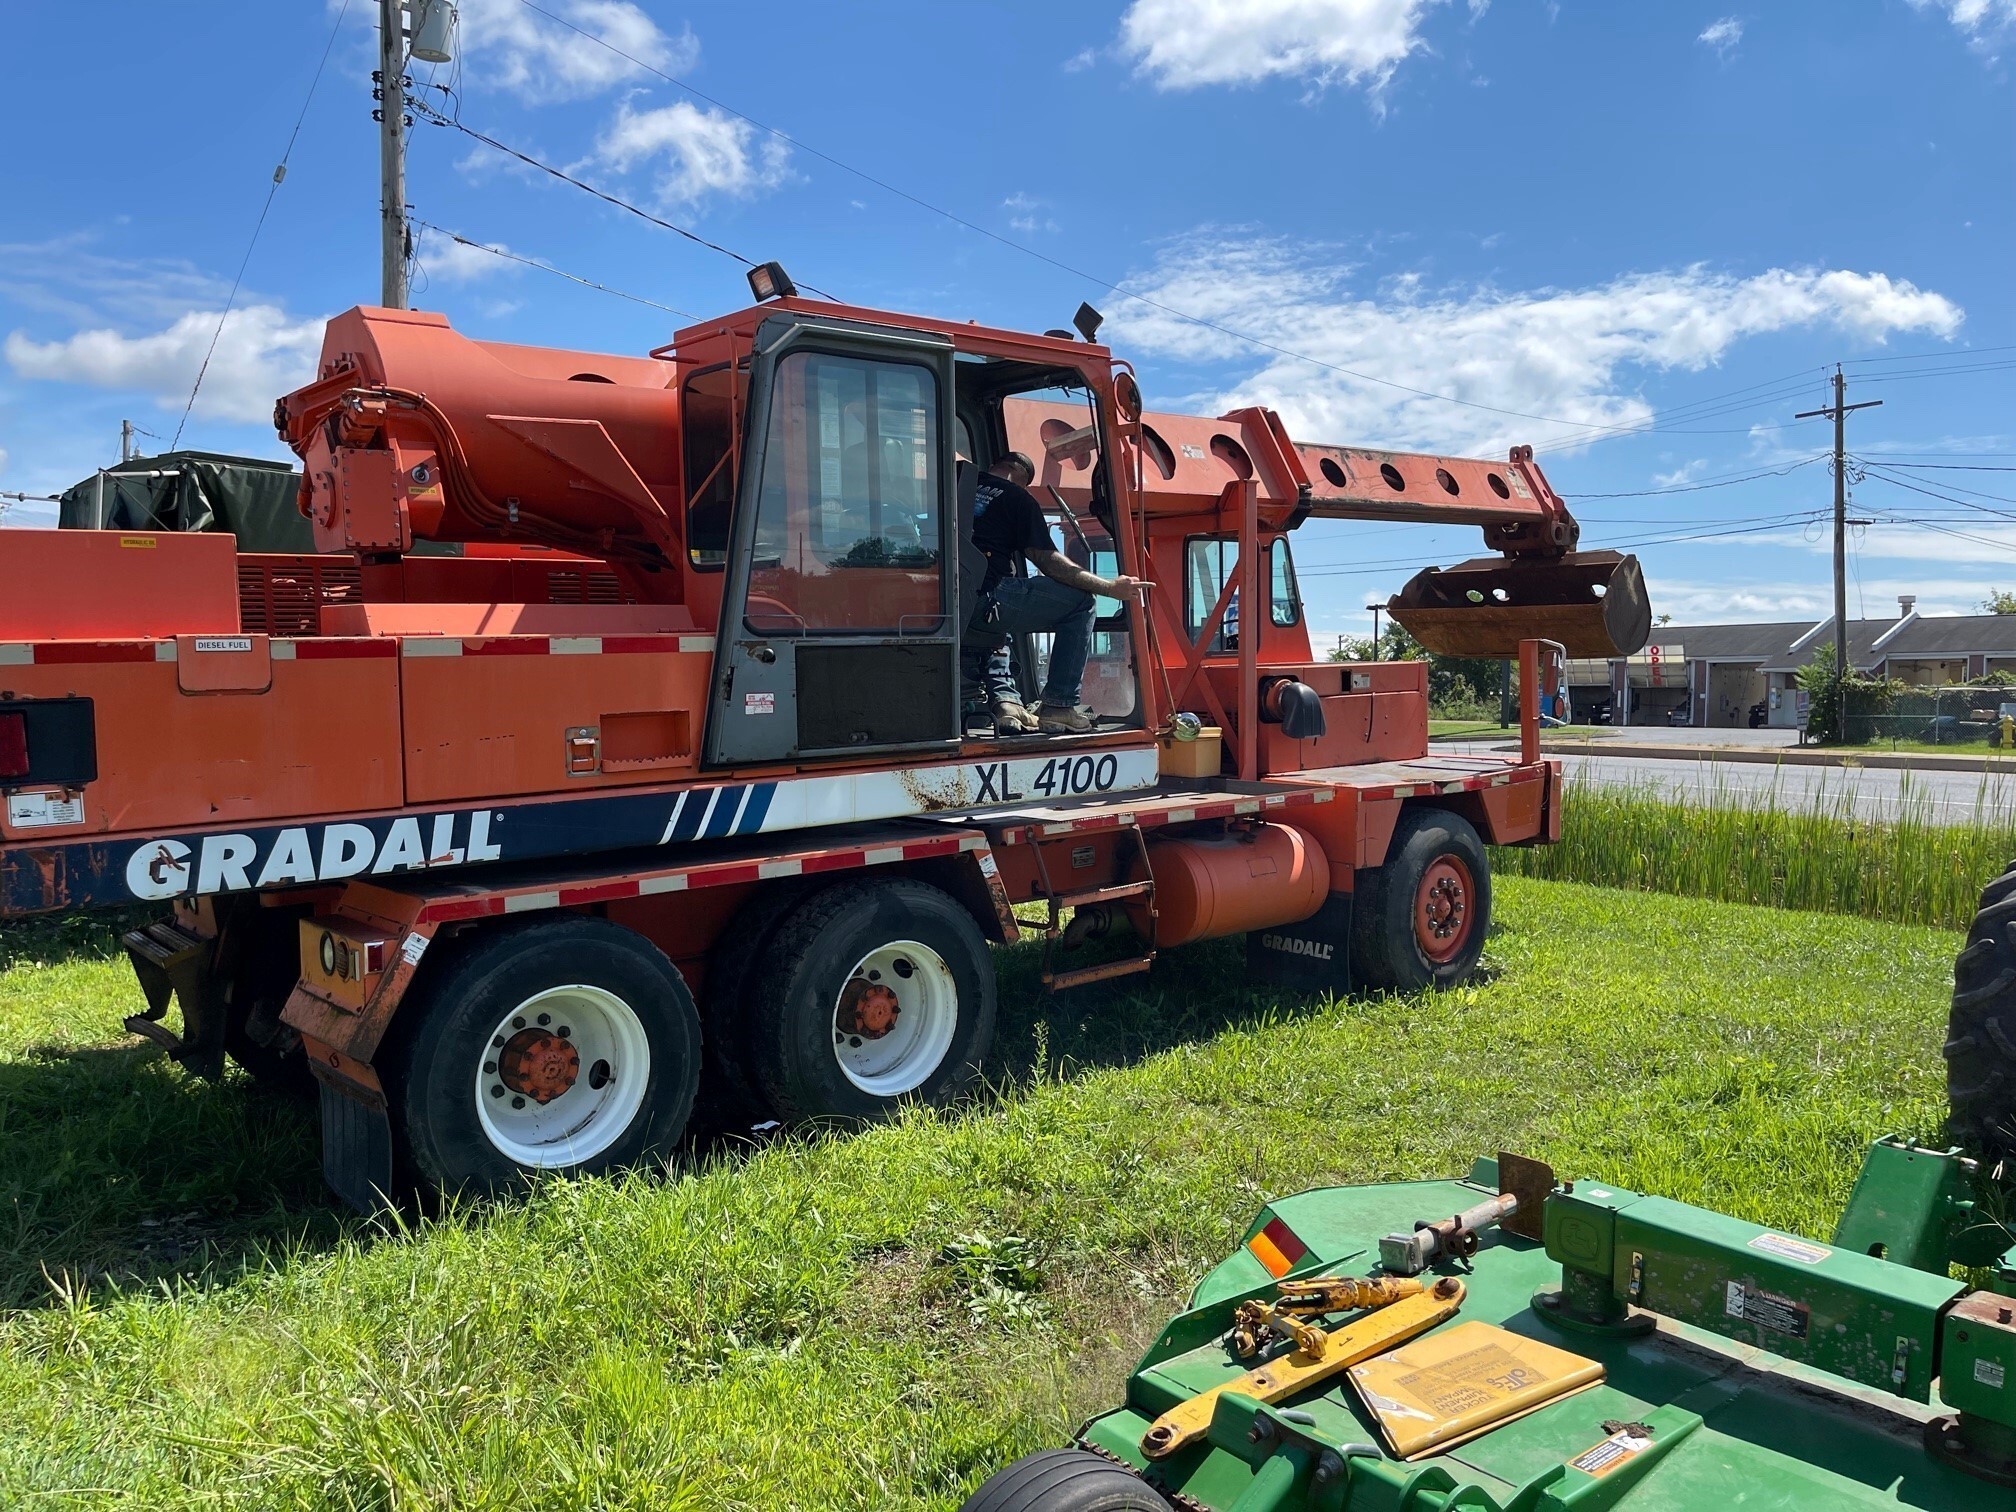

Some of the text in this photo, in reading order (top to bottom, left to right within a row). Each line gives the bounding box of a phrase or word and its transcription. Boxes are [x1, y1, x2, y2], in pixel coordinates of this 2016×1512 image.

[198, 641, 249, 649] DIESEL FUEL
[1650, 645, 1662, 687] OPEN
[974, 754, 1118, 804] XL 4100
[126, 810, 502, 900] GRADALL
[1261, 934, 1332, 960] GRADALL
[1765, 1292, 1797, 1308] DANGER
